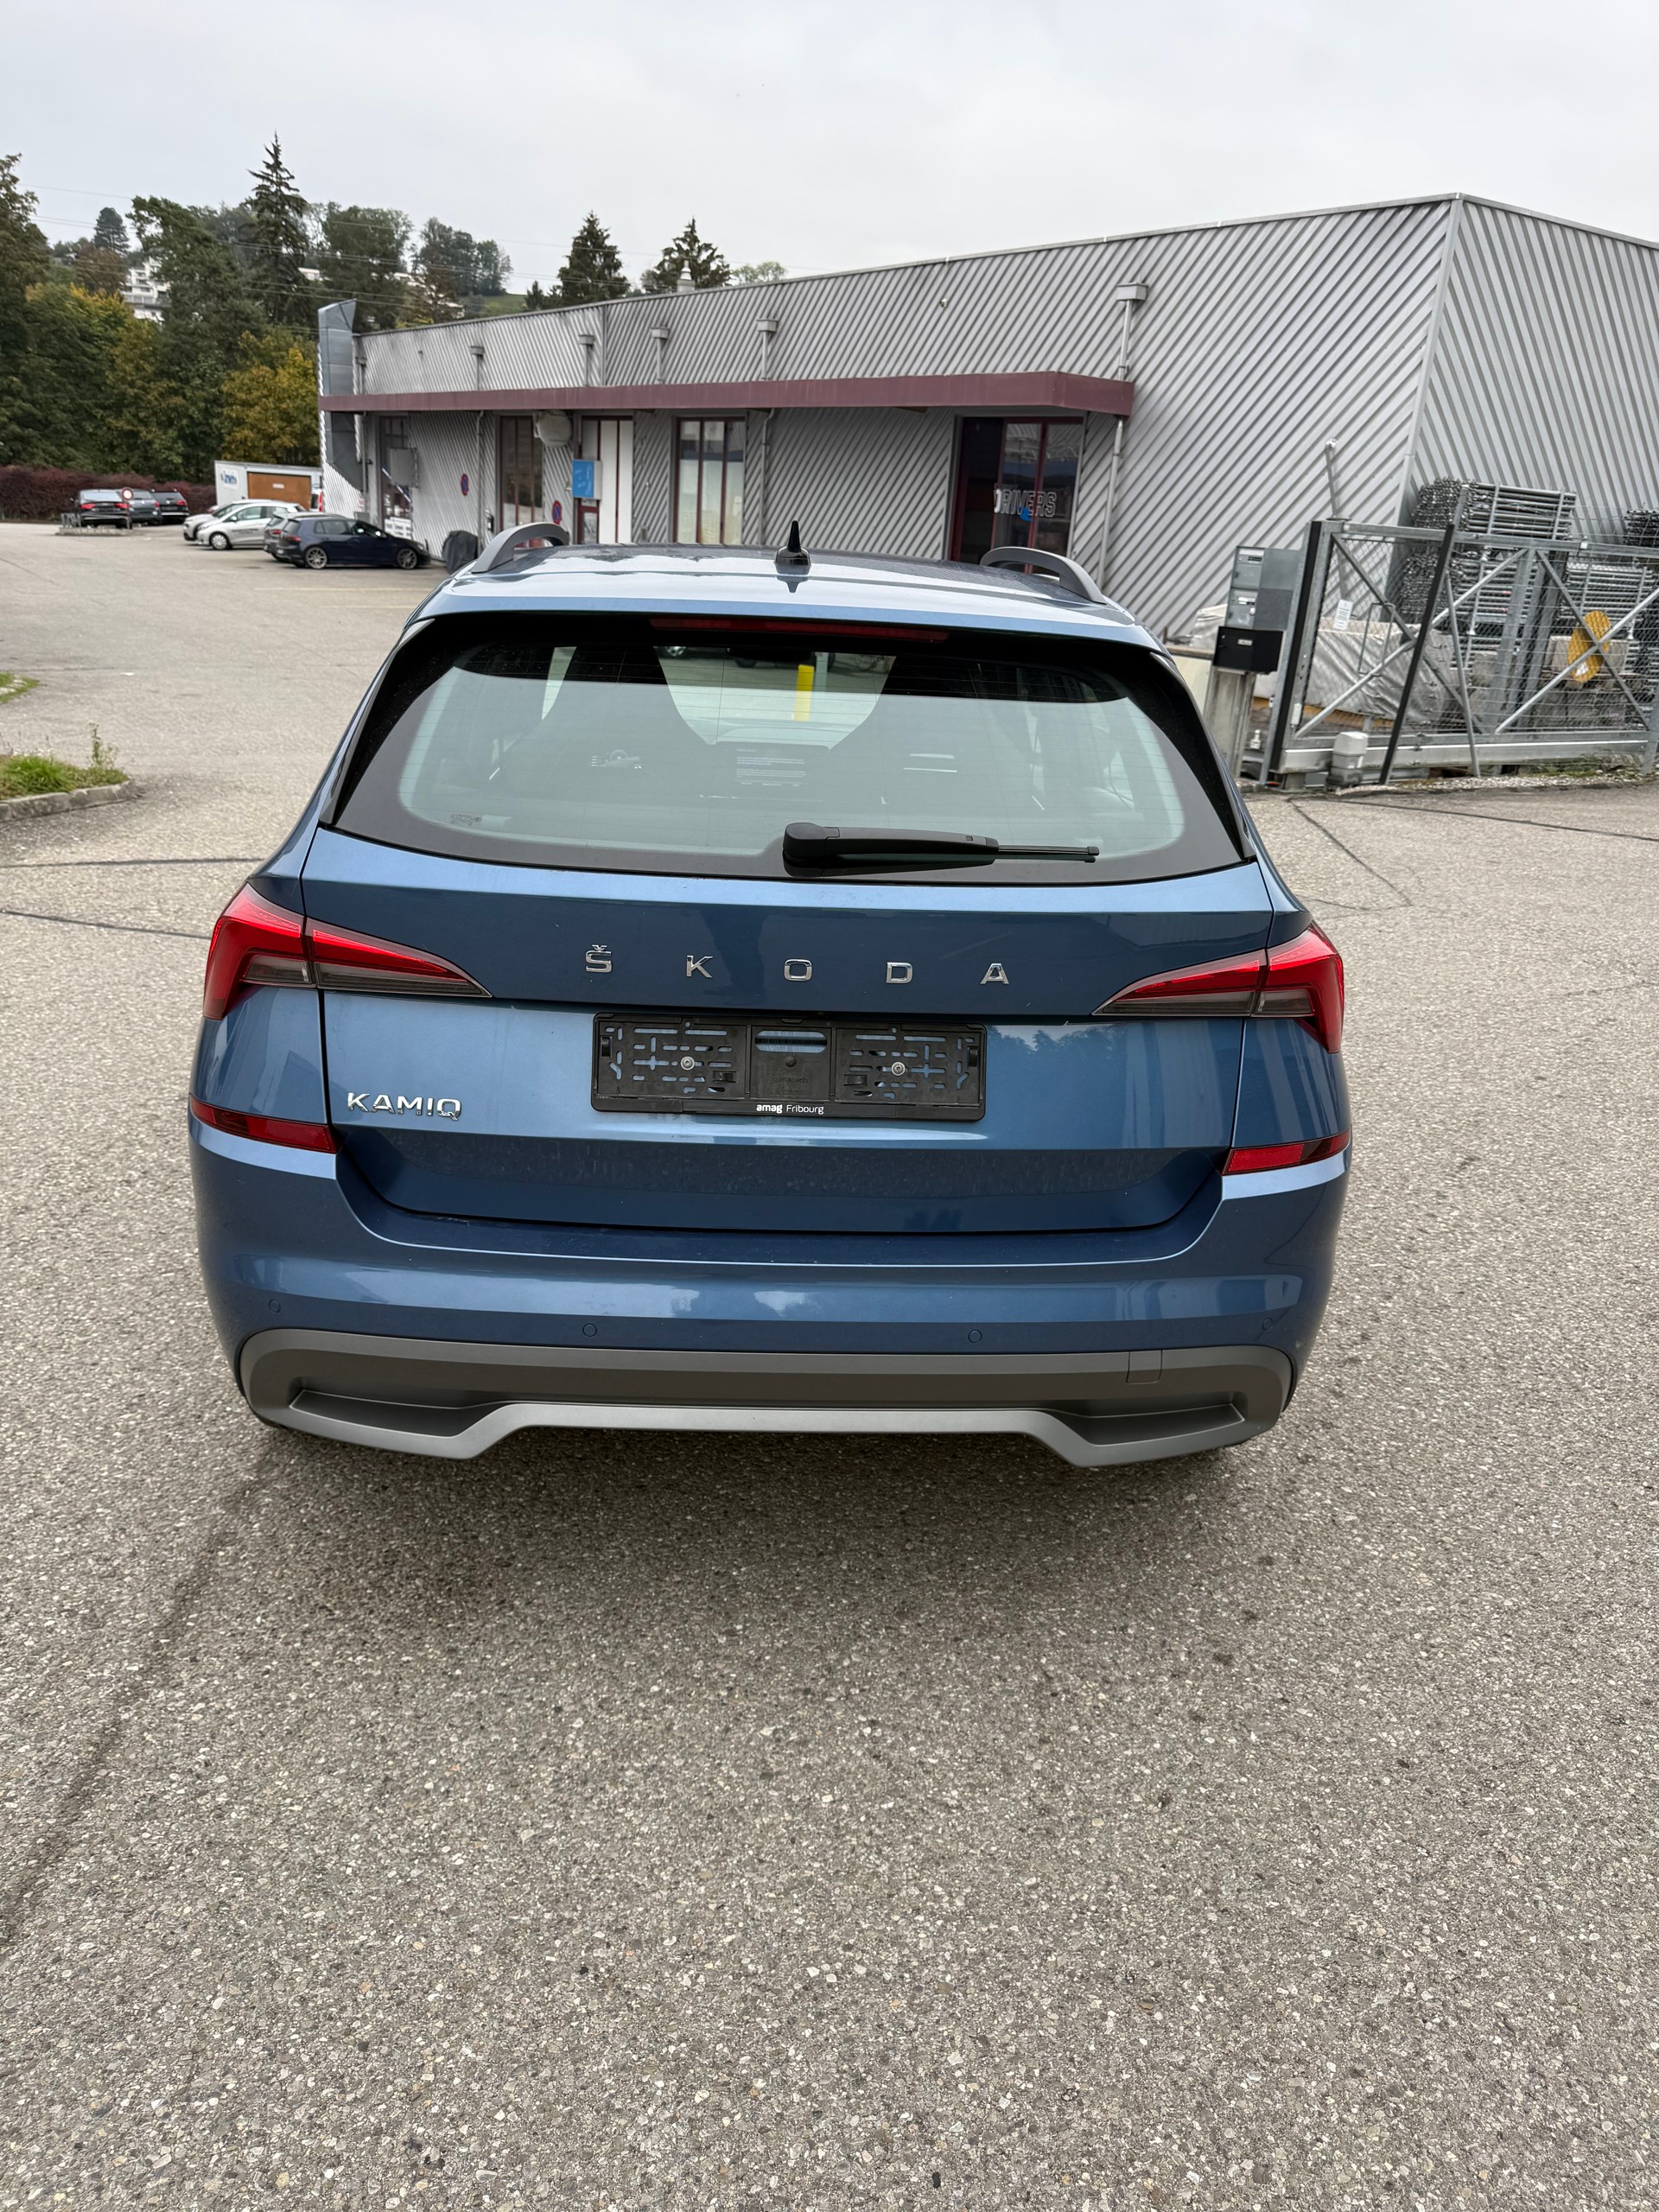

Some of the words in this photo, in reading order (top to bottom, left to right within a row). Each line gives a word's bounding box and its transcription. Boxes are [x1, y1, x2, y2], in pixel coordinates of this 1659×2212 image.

[585, 944, 1010, 985] ŠKODA
[346, 1092, 461, 1121] KAMIQ
[756, 1104, 783, 1114] amag
[785, 1104, 824, 1115] Fribourg
